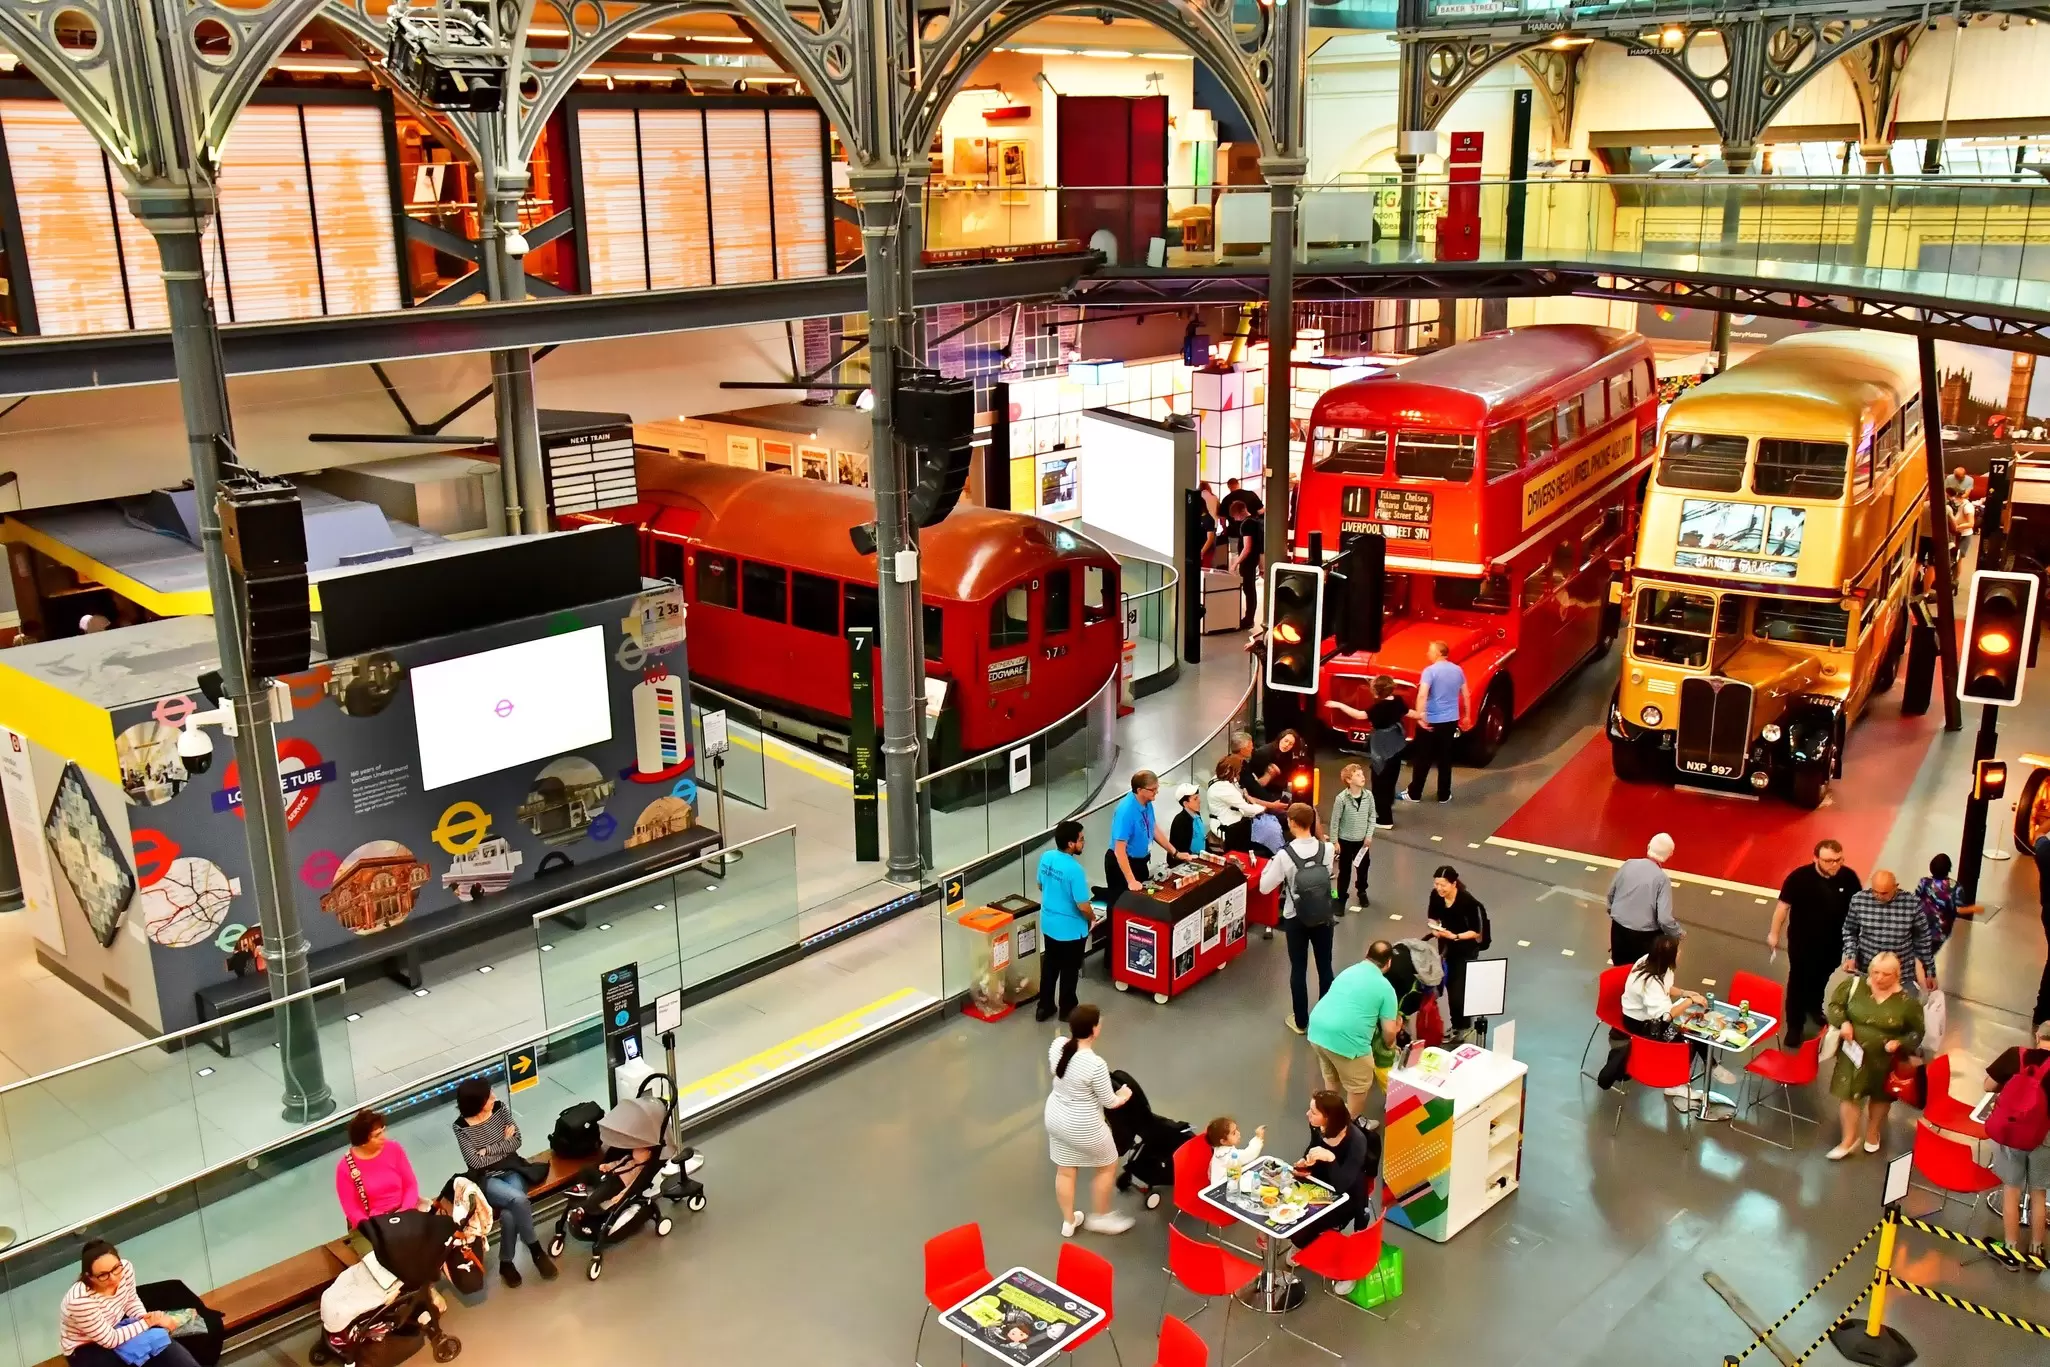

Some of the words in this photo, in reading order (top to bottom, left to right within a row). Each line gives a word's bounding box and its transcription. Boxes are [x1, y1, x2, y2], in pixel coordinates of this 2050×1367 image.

[1440, 6, 1465, 14] BAKER
[1470, 3, 1498, 12] STREET
[1527, 22, 1566, 31] HARROW
[1630, 47, 1671, 56] HAMPSTEAD
[1520, 93, 1528, 104] 5
[570, 436, 592, 445] NEXT
[591, 433, 610, 442] TRAIN
[1992, 464, 2005, 474] 12
[1348, 487, 1362, 513] 11
[1380, 490, 1401, 500] Fulham
[1404, 492, 1428, 503] Chelsea
[1527, 479, 1556, 516] DRIVERS
[1377, 499, 1400, 510] Victoria
[1403, 502, 1424, 513] Charing
[1393, 510, 1412, 520] Street
[1414, 511, 1429, 522] Bank
[1341, 521, 1382, 535] LIVERPOOL
[1382, 524, 1411, 539] STREET
[1414, 528, 1430, 540] STN
[1738, 560, 1776, 575] GARAGE
[1032, 580, 1039, 590] D
[644, 608, 650, 620] 1
[657, 605, 665, 617] 2
[666, 603, 680, 615] 3a
[855, 637, 865, 651] 7
[988, 666, 1024, 682] EDGWARE
[375, 763, 382, 771] of
[1686, 760, 1708, 772] NXP
[1711, 765, 1733, 776] 997
[290, 769, 323, 788] TUBE
[351, 775, 373, 785] London
[372, 764, 409, 779] Underground
[287, 795, 309, 822] SERVICE
[614, 1002, 628, 1012] GIVE
